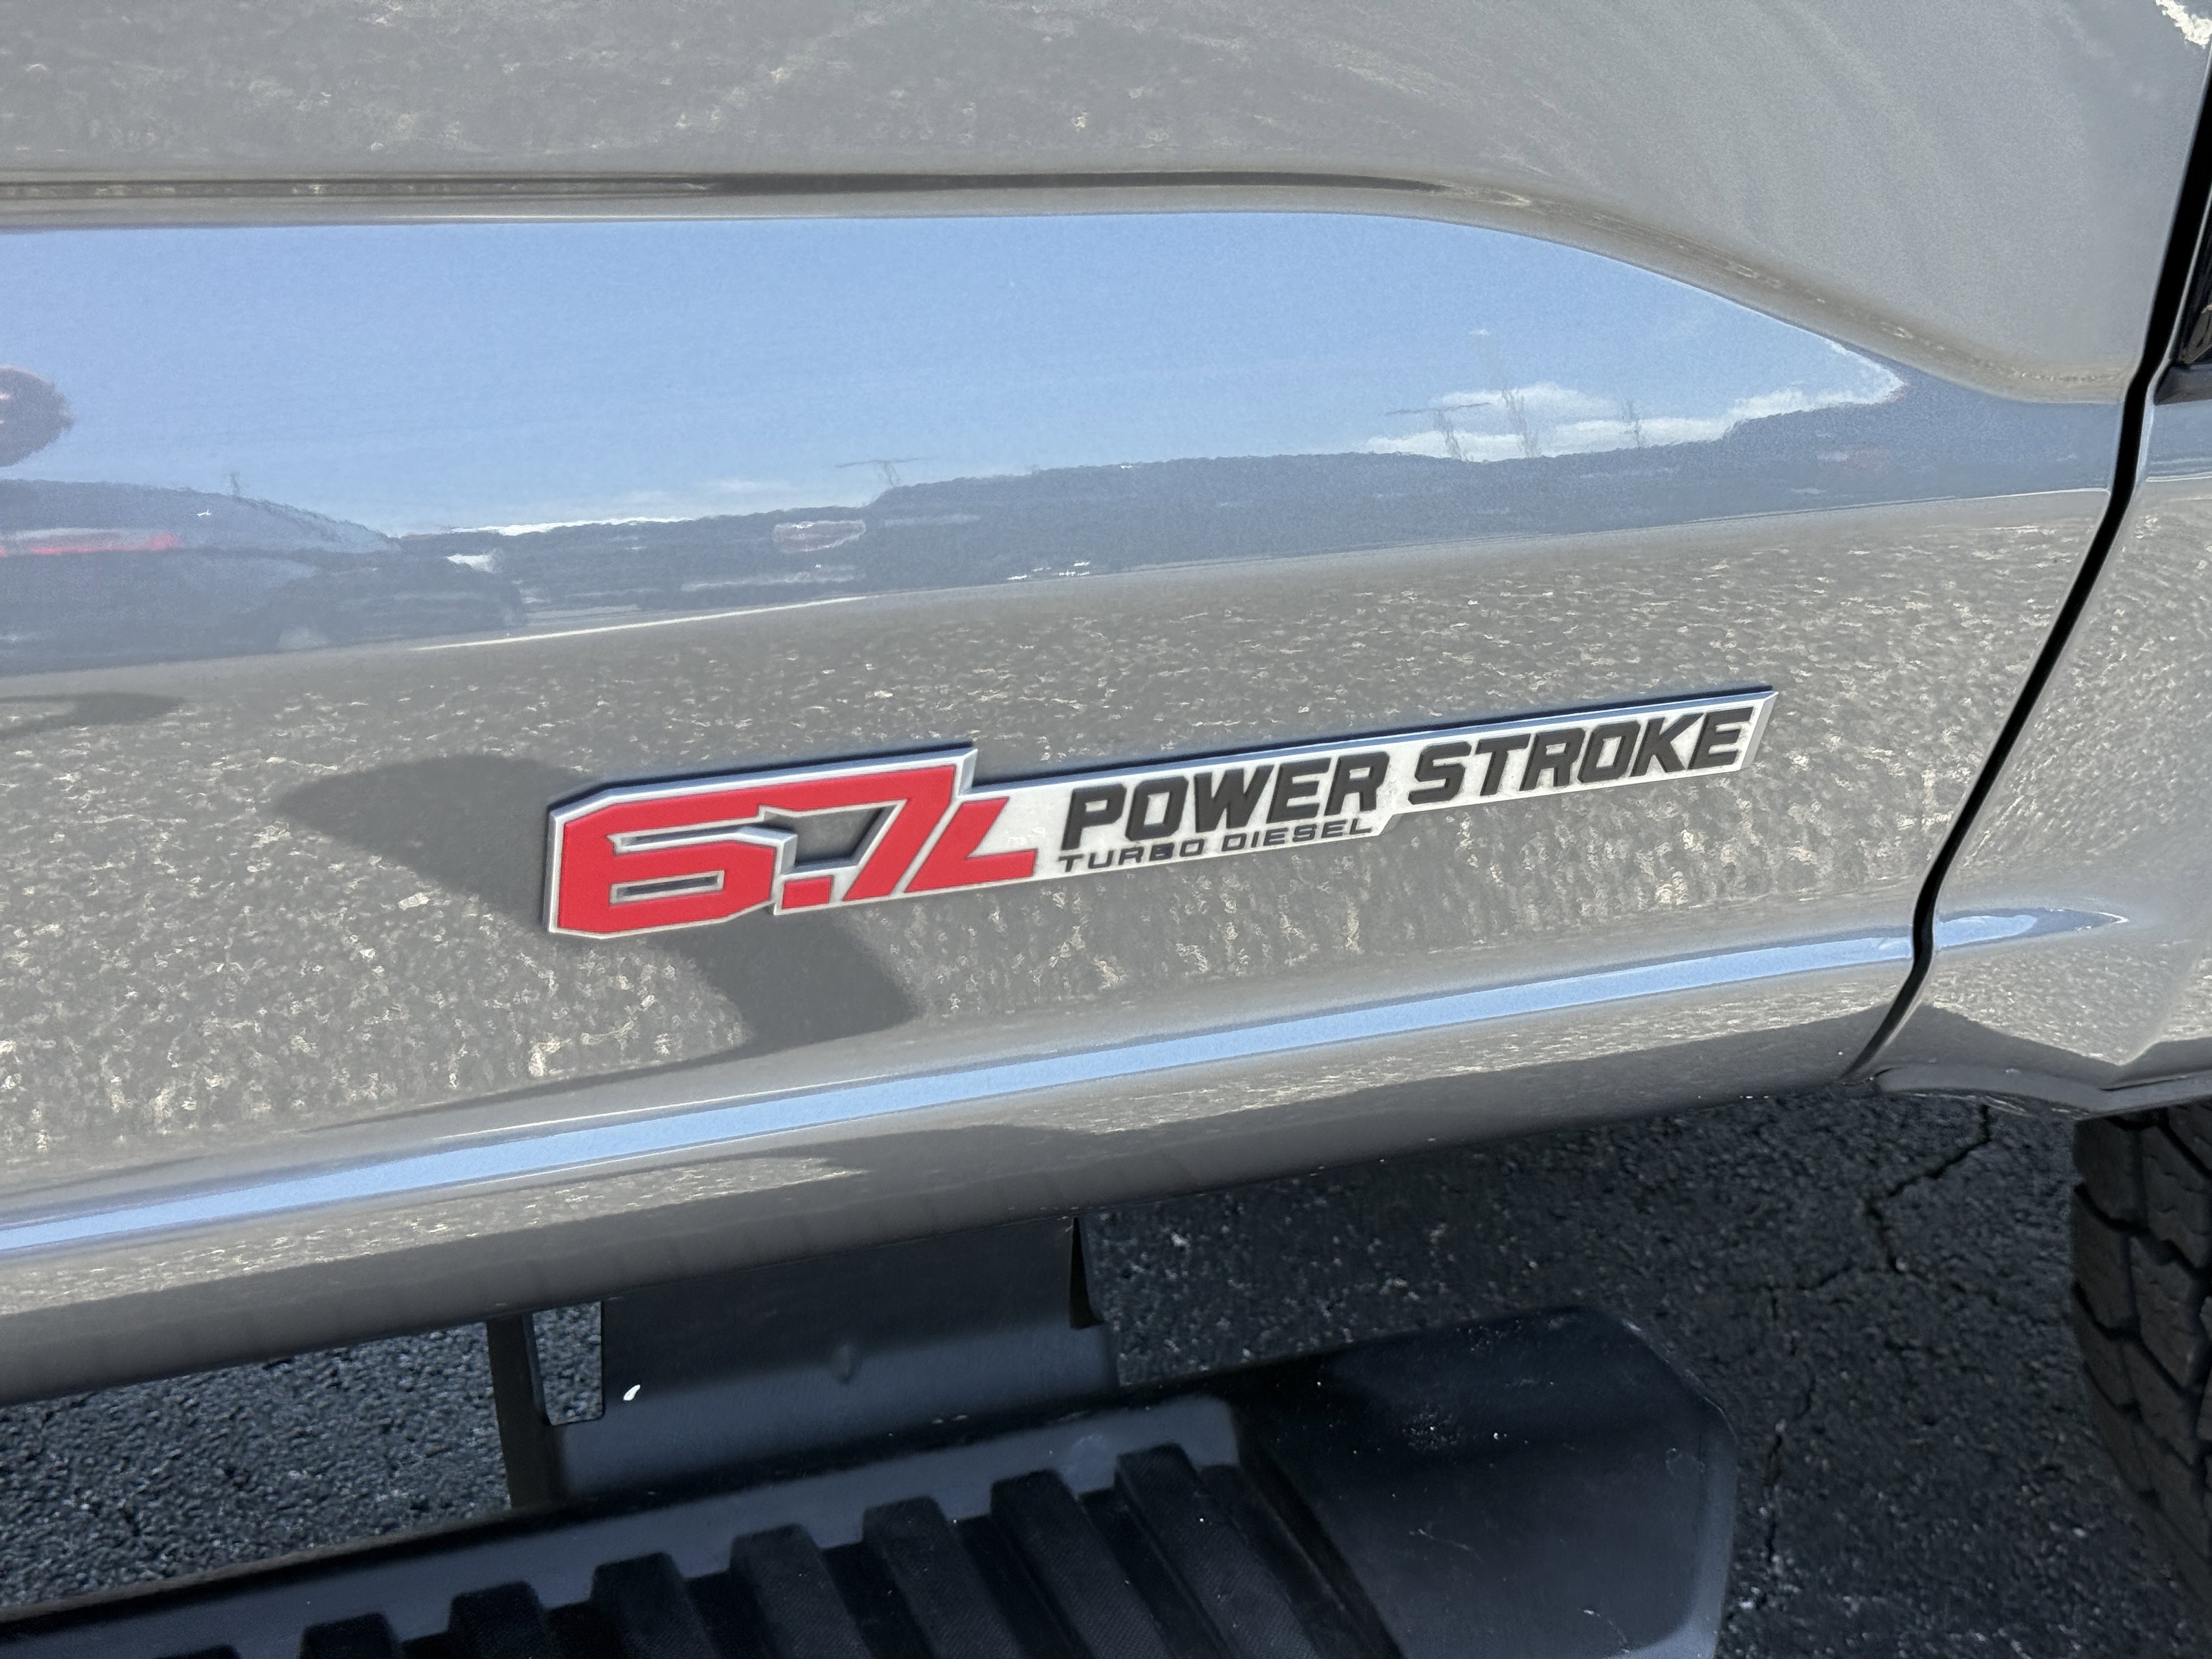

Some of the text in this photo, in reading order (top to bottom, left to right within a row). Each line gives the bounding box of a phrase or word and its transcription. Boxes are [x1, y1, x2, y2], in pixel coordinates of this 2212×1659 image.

[556, 706, 1754, 934] 6.7L POWER STROKE
[1058, 817, 1373, 872] TURBO DIESEL
